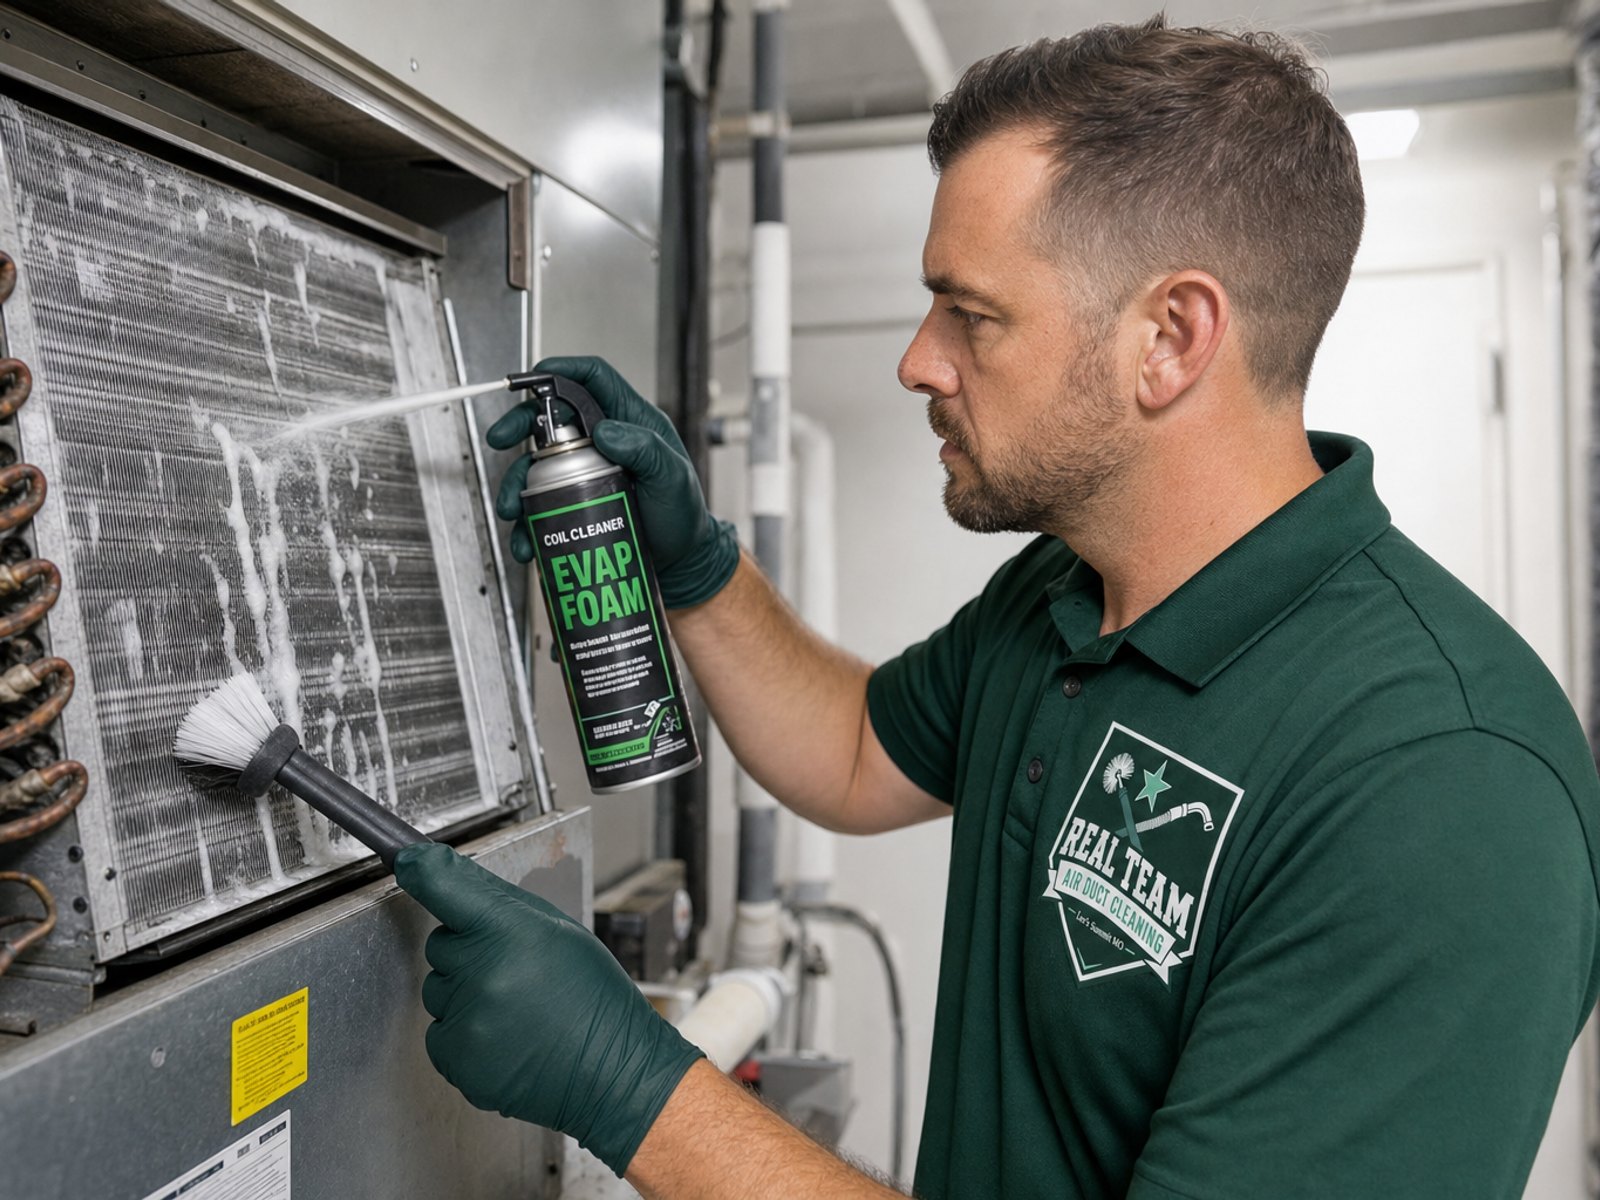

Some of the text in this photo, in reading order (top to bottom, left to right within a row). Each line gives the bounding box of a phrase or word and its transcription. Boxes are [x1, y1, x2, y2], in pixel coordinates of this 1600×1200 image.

[544, 516, 625, 547] COIL CLEANER
[550, 541, 632, 593] EVAP
[559, 577, 646, 630] FOAM
[1059, 816, 1195, 940] REAL TEAM
[1062, 868, 1165, 955] AIR DUCT CLEANING
[1112, 936, 1125, 951] MO
